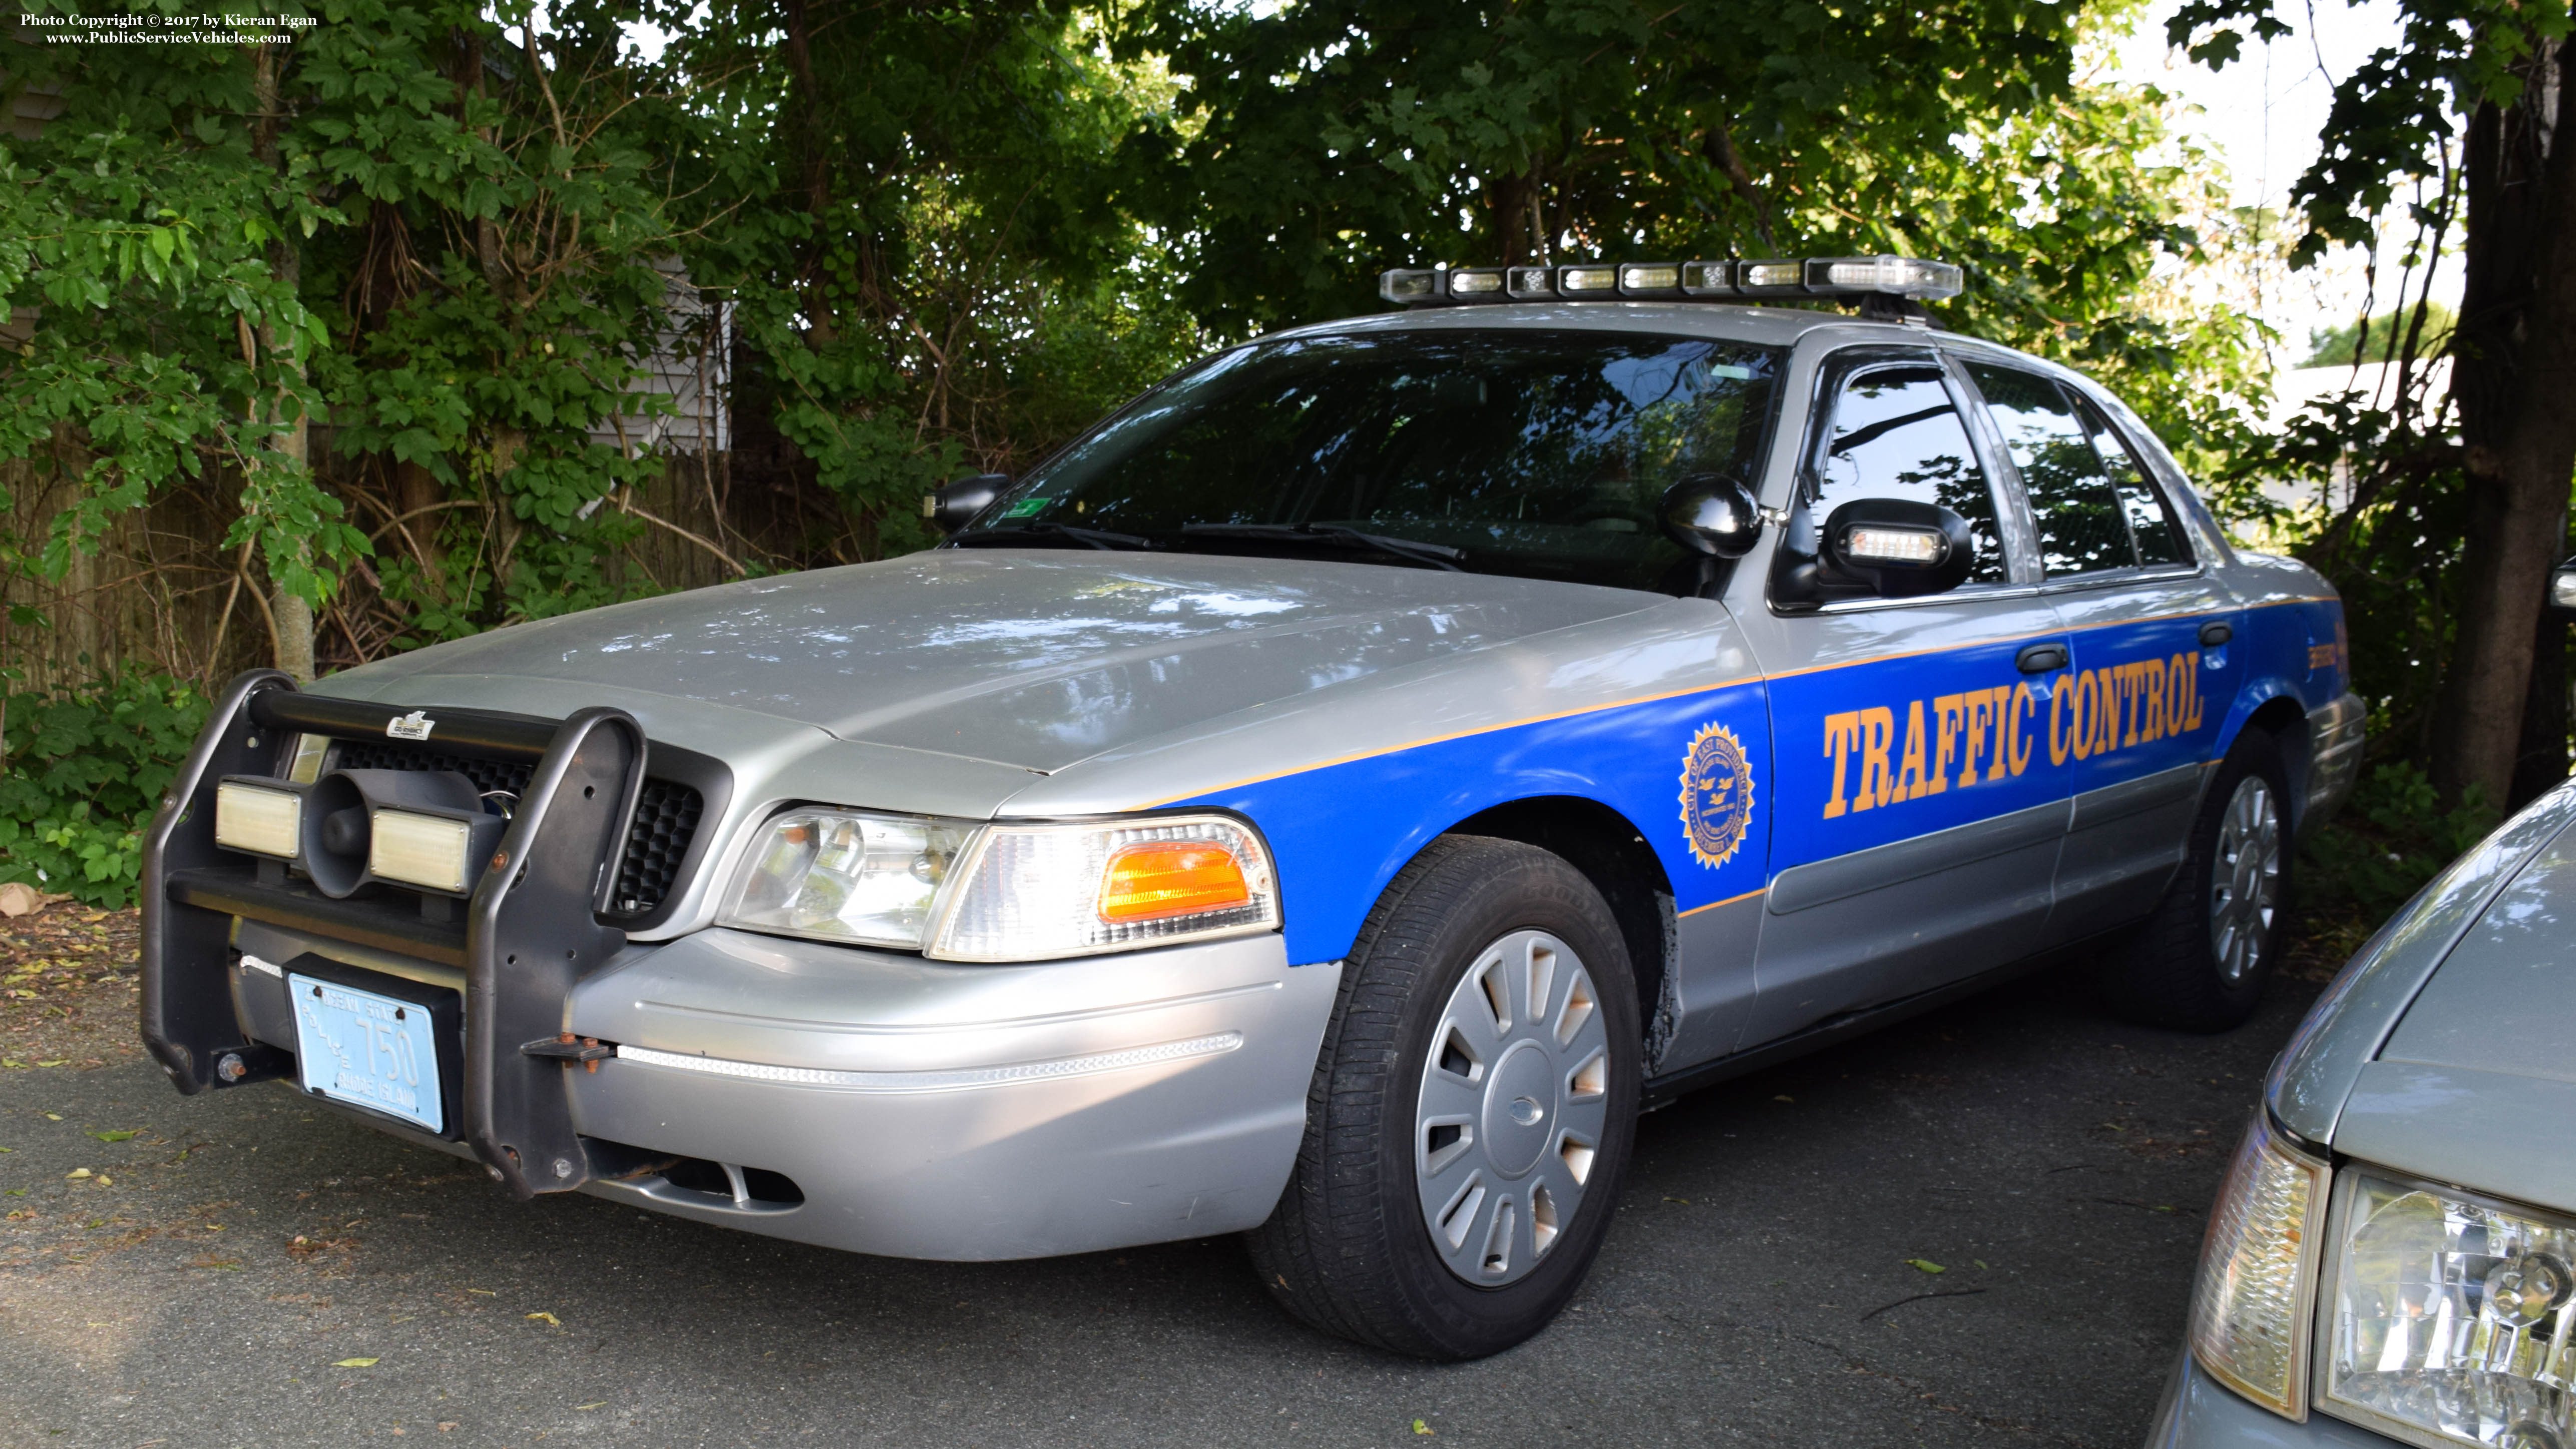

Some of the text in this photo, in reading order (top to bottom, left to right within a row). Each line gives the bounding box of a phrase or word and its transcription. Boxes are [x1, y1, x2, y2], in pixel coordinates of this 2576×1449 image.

[1823, 652, 2204, 819] TRAFFIC CONTROL
[324, 992, 359, 1014] OCEAN
[356, 1018, 418, 1087] 750
[337, 1073, 416, 1110] RHODE ISLAND
